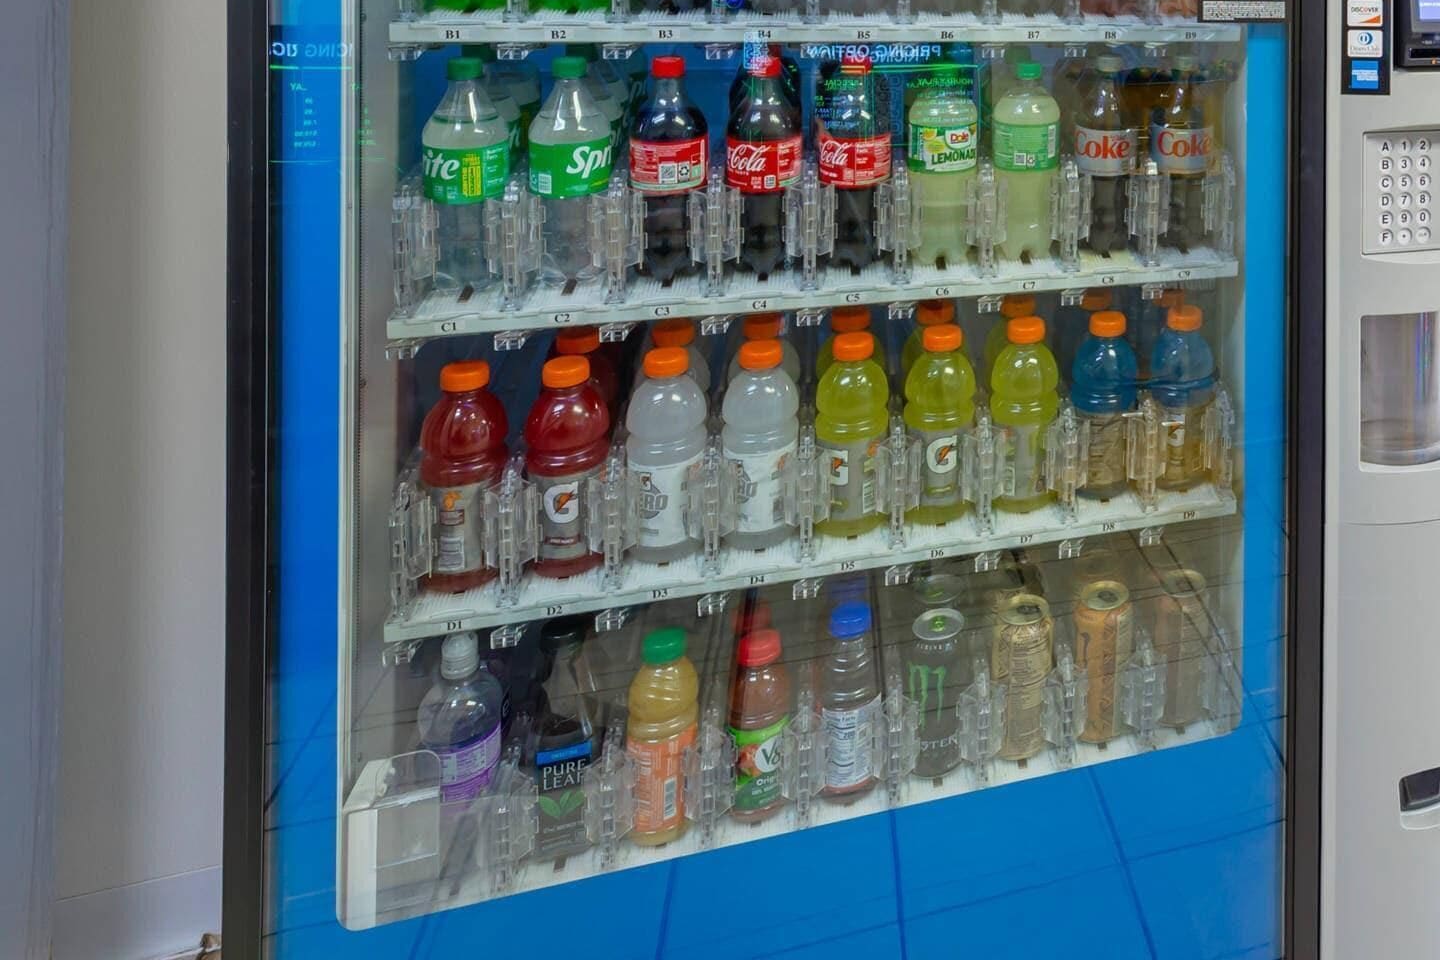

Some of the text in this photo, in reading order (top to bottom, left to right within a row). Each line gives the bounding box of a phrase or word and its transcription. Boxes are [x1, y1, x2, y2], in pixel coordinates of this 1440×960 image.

[1351, 6, 1379, 14] DISCOVER
[445, 29, 1197, 40] B1 B2 B3 B4 B5 B6 B7 B8 B9
[1073, 129, 1131, 159] Coke
[1157, 130, 1211, 158] Coke
[1382, 141, 1426, 152] A 1 2
[729, 143, 766, 172] Cola
[1382, 159, 1426, 170] B 3 4
[1382, 177, 1426, 188] C 5 6
[1382, 194, 1426, 206] D 7 8
[1382, 213, 1426, 224] E 9 0
[1382, 233, 1388, 242] F
[441, 270, 1191, 332] C1 C2 C3 C4 C5 C6 C7 C8 C9
[447, 511, 1195, 631] D1 D2 D3 D4 D5 D6 D7 D8 D9
[543, 758, 586, 778] PURE
